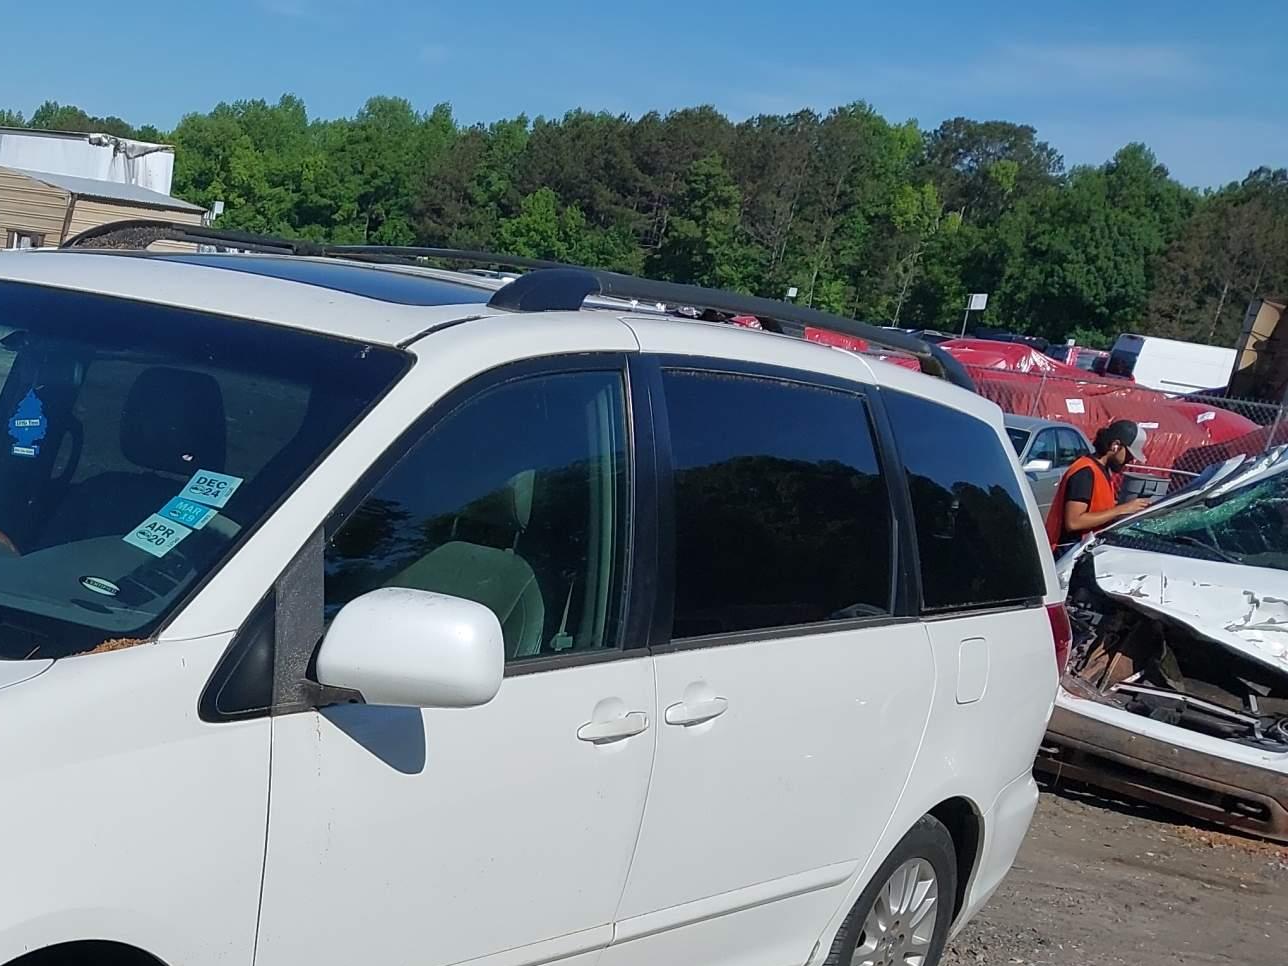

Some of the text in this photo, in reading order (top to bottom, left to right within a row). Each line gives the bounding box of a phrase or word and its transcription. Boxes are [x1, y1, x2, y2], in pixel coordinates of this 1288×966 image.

[196, 477, 228, 489] DEC
[202, 488, 221, 498] 24
[175, 501, 202, 515] MAR
[145, 522, 175, 538] APR
[148, 534, 166, 546] 20
